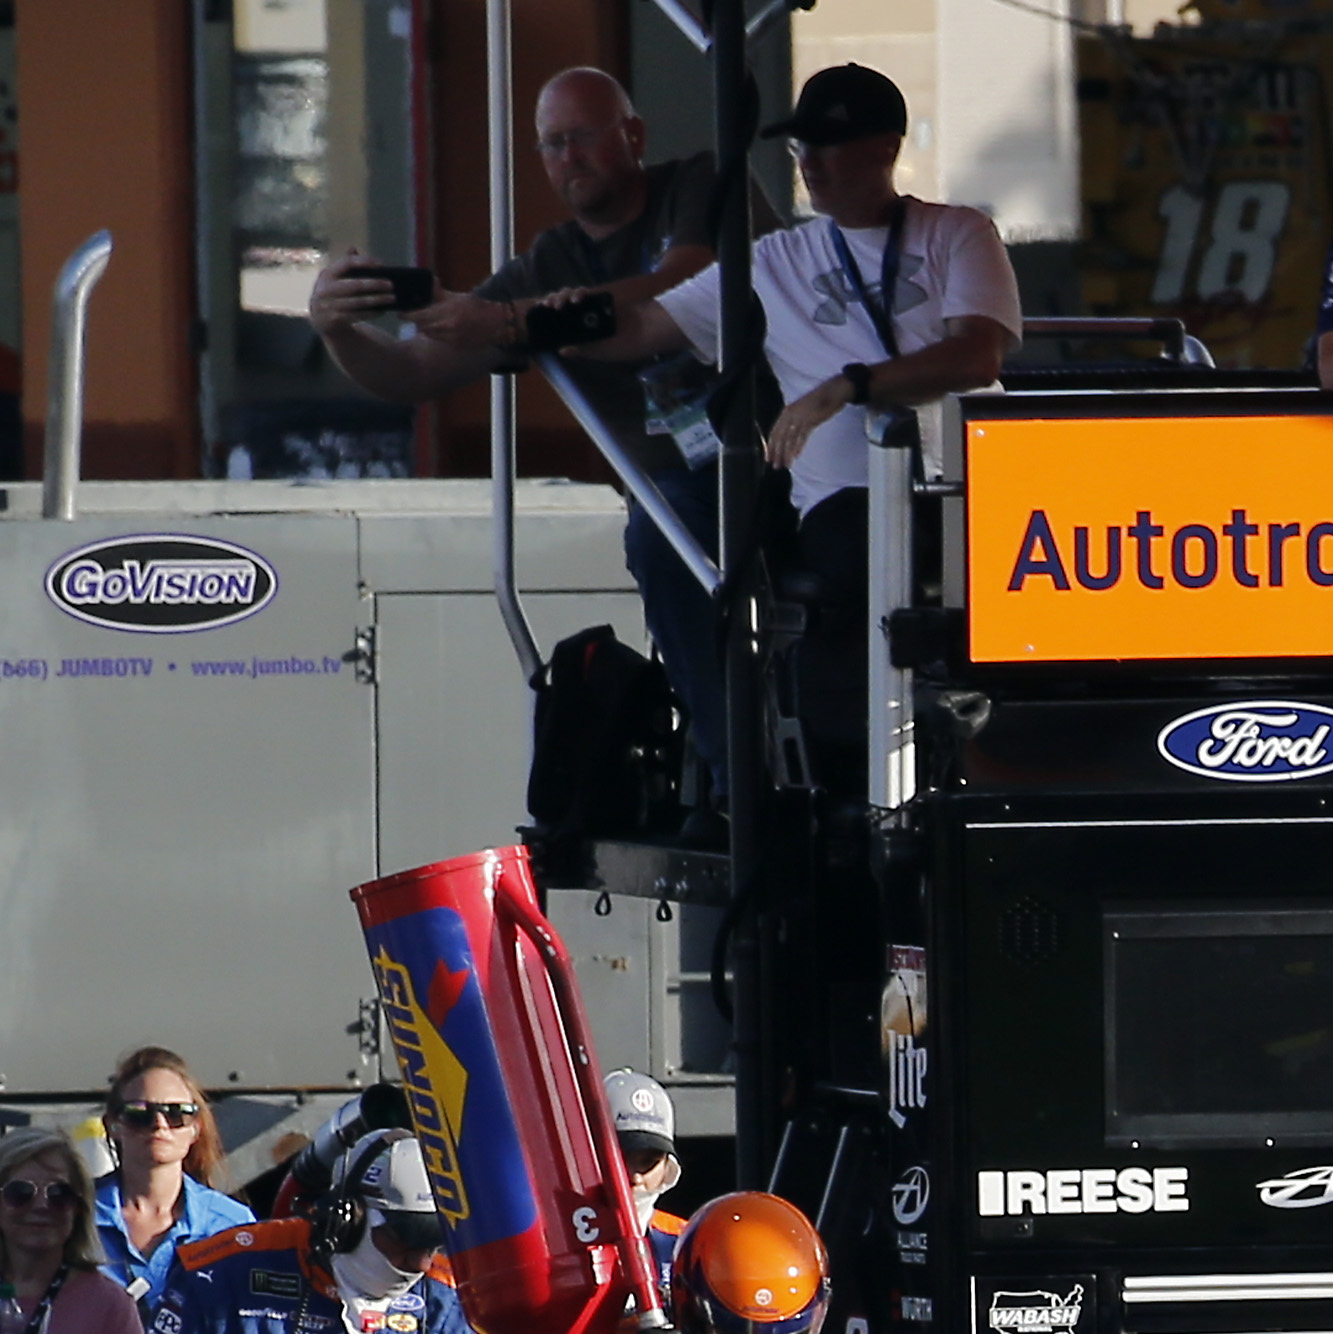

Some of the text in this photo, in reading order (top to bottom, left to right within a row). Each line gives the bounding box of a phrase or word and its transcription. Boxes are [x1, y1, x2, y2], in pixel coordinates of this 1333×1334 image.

[1153, 183, 1291, 303] 18
[66, 562, 254, 601] GoVision
[56, 657, 153, 678] JUMBOTV
[191, 655, 342, 682] www.jumbo.tv
[887, 1030, 928, 1128] Lite
[1007, 1168, 1189, 1215] REESE
[992, 1307, 1079, 1326] WABASH
